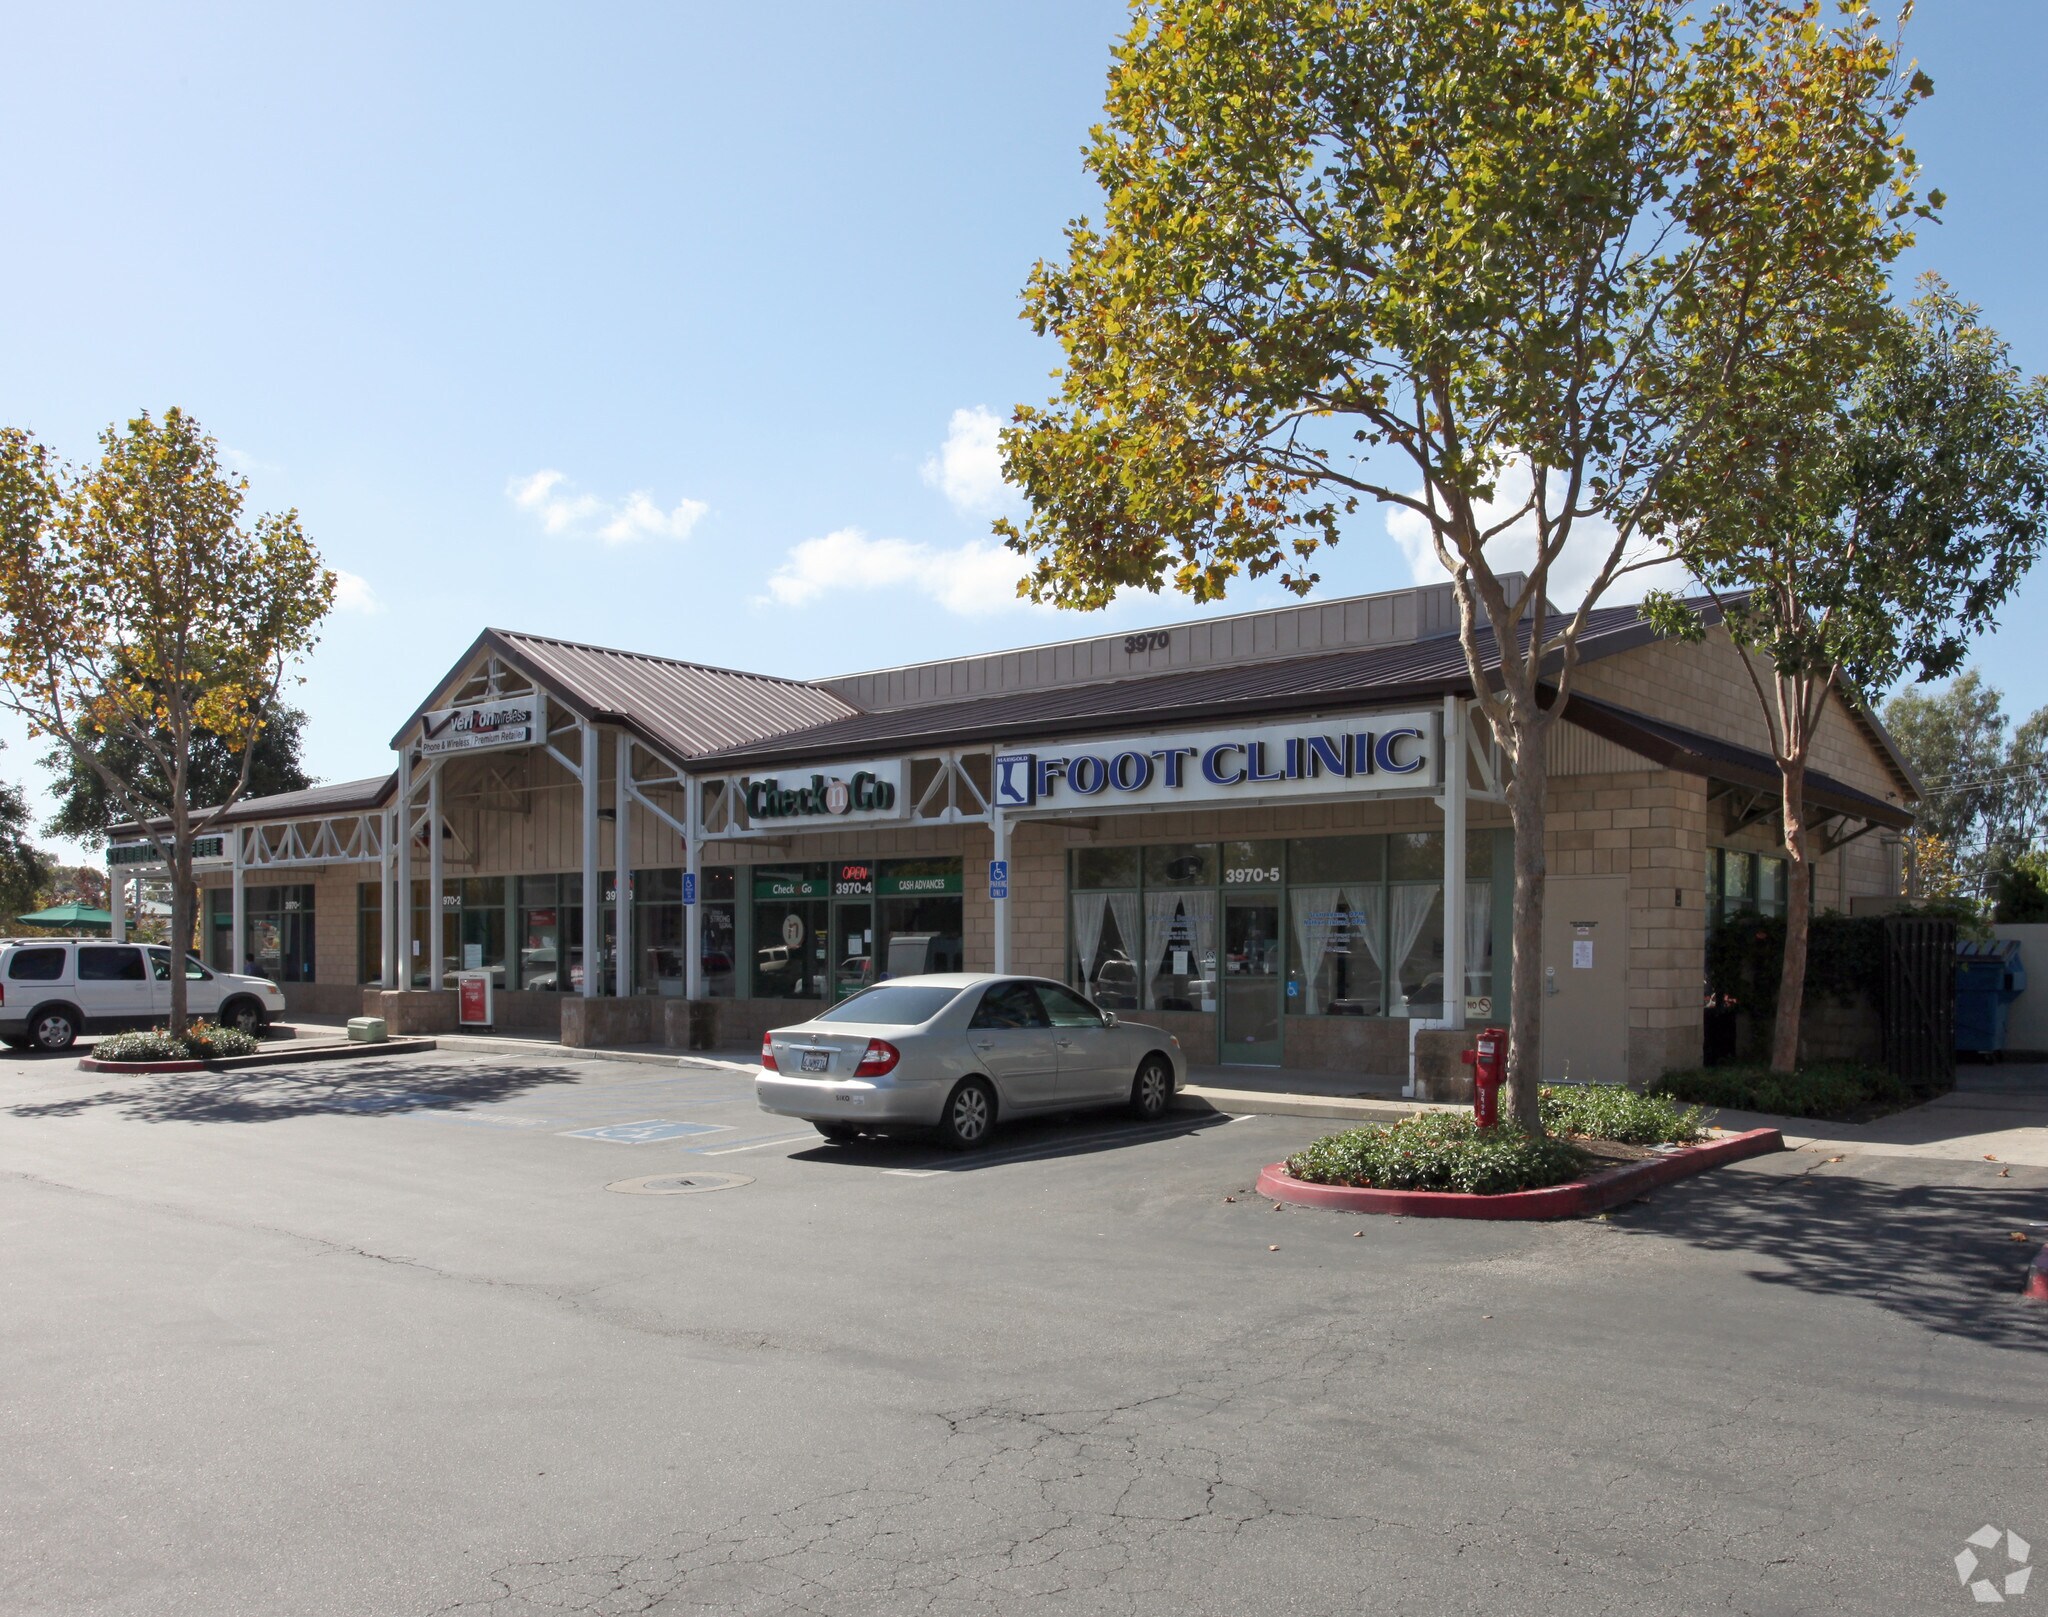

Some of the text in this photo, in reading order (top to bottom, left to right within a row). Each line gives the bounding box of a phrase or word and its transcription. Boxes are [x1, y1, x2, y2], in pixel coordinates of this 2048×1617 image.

[1124, 631, 1170, 653] 3970
[451, 709, 532, 732] verizon wireless
[422, 730, 525, 752] Phone & Wireless Premium Retailer
[1036, 728, 1425, 797] FOOT CLINIC
[746, 774, 830, 819] Check
[850, 770, 896, 812] Go
[106, 842, 174, 864] STARBUC
[842, 866, 868, 880] OPEN
[1225, 867, 1280, 883] 3970-5
[772, 884, 795, 895] Check
[801, 883, 813, 894] Go
[835, 882, 873, 895] 3970-4
[898, 879, 945, 890] CASH ADVANCES
[605, 891, 634, 901] 393
[993, 889, 1005, 897] ONLY
[442, 896, 462, 905] 970-2
[1467, 1001, 1477, 1009] NO
